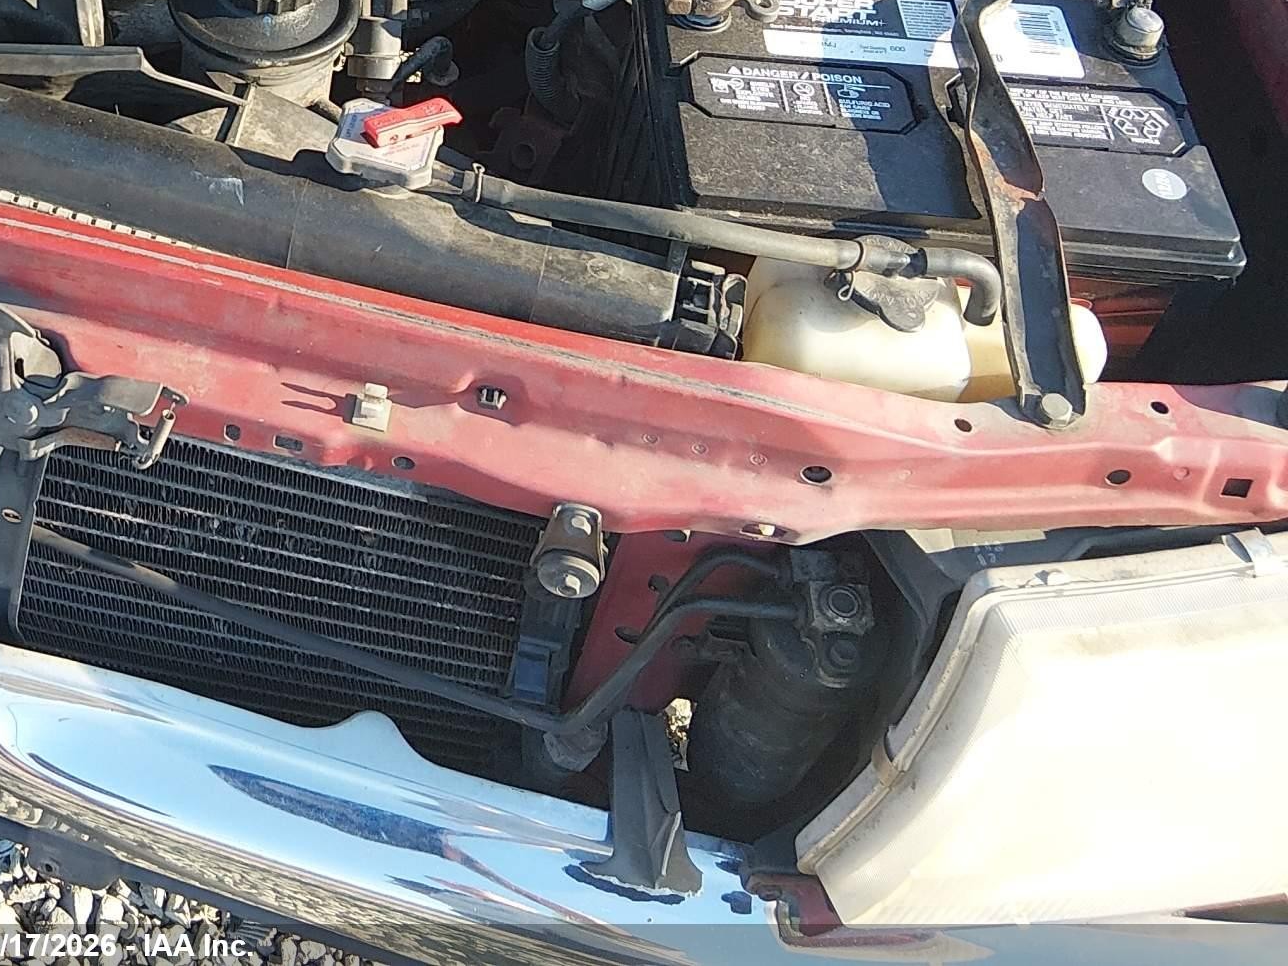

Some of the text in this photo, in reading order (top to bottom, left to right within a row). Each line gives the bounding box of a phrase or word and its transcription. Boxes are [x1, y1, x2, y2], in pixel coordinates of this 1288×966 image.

[778, 5, 877, 22] START
[742, 66, 798, 80] DANGER
[812, 72, 862, 84] POISON
